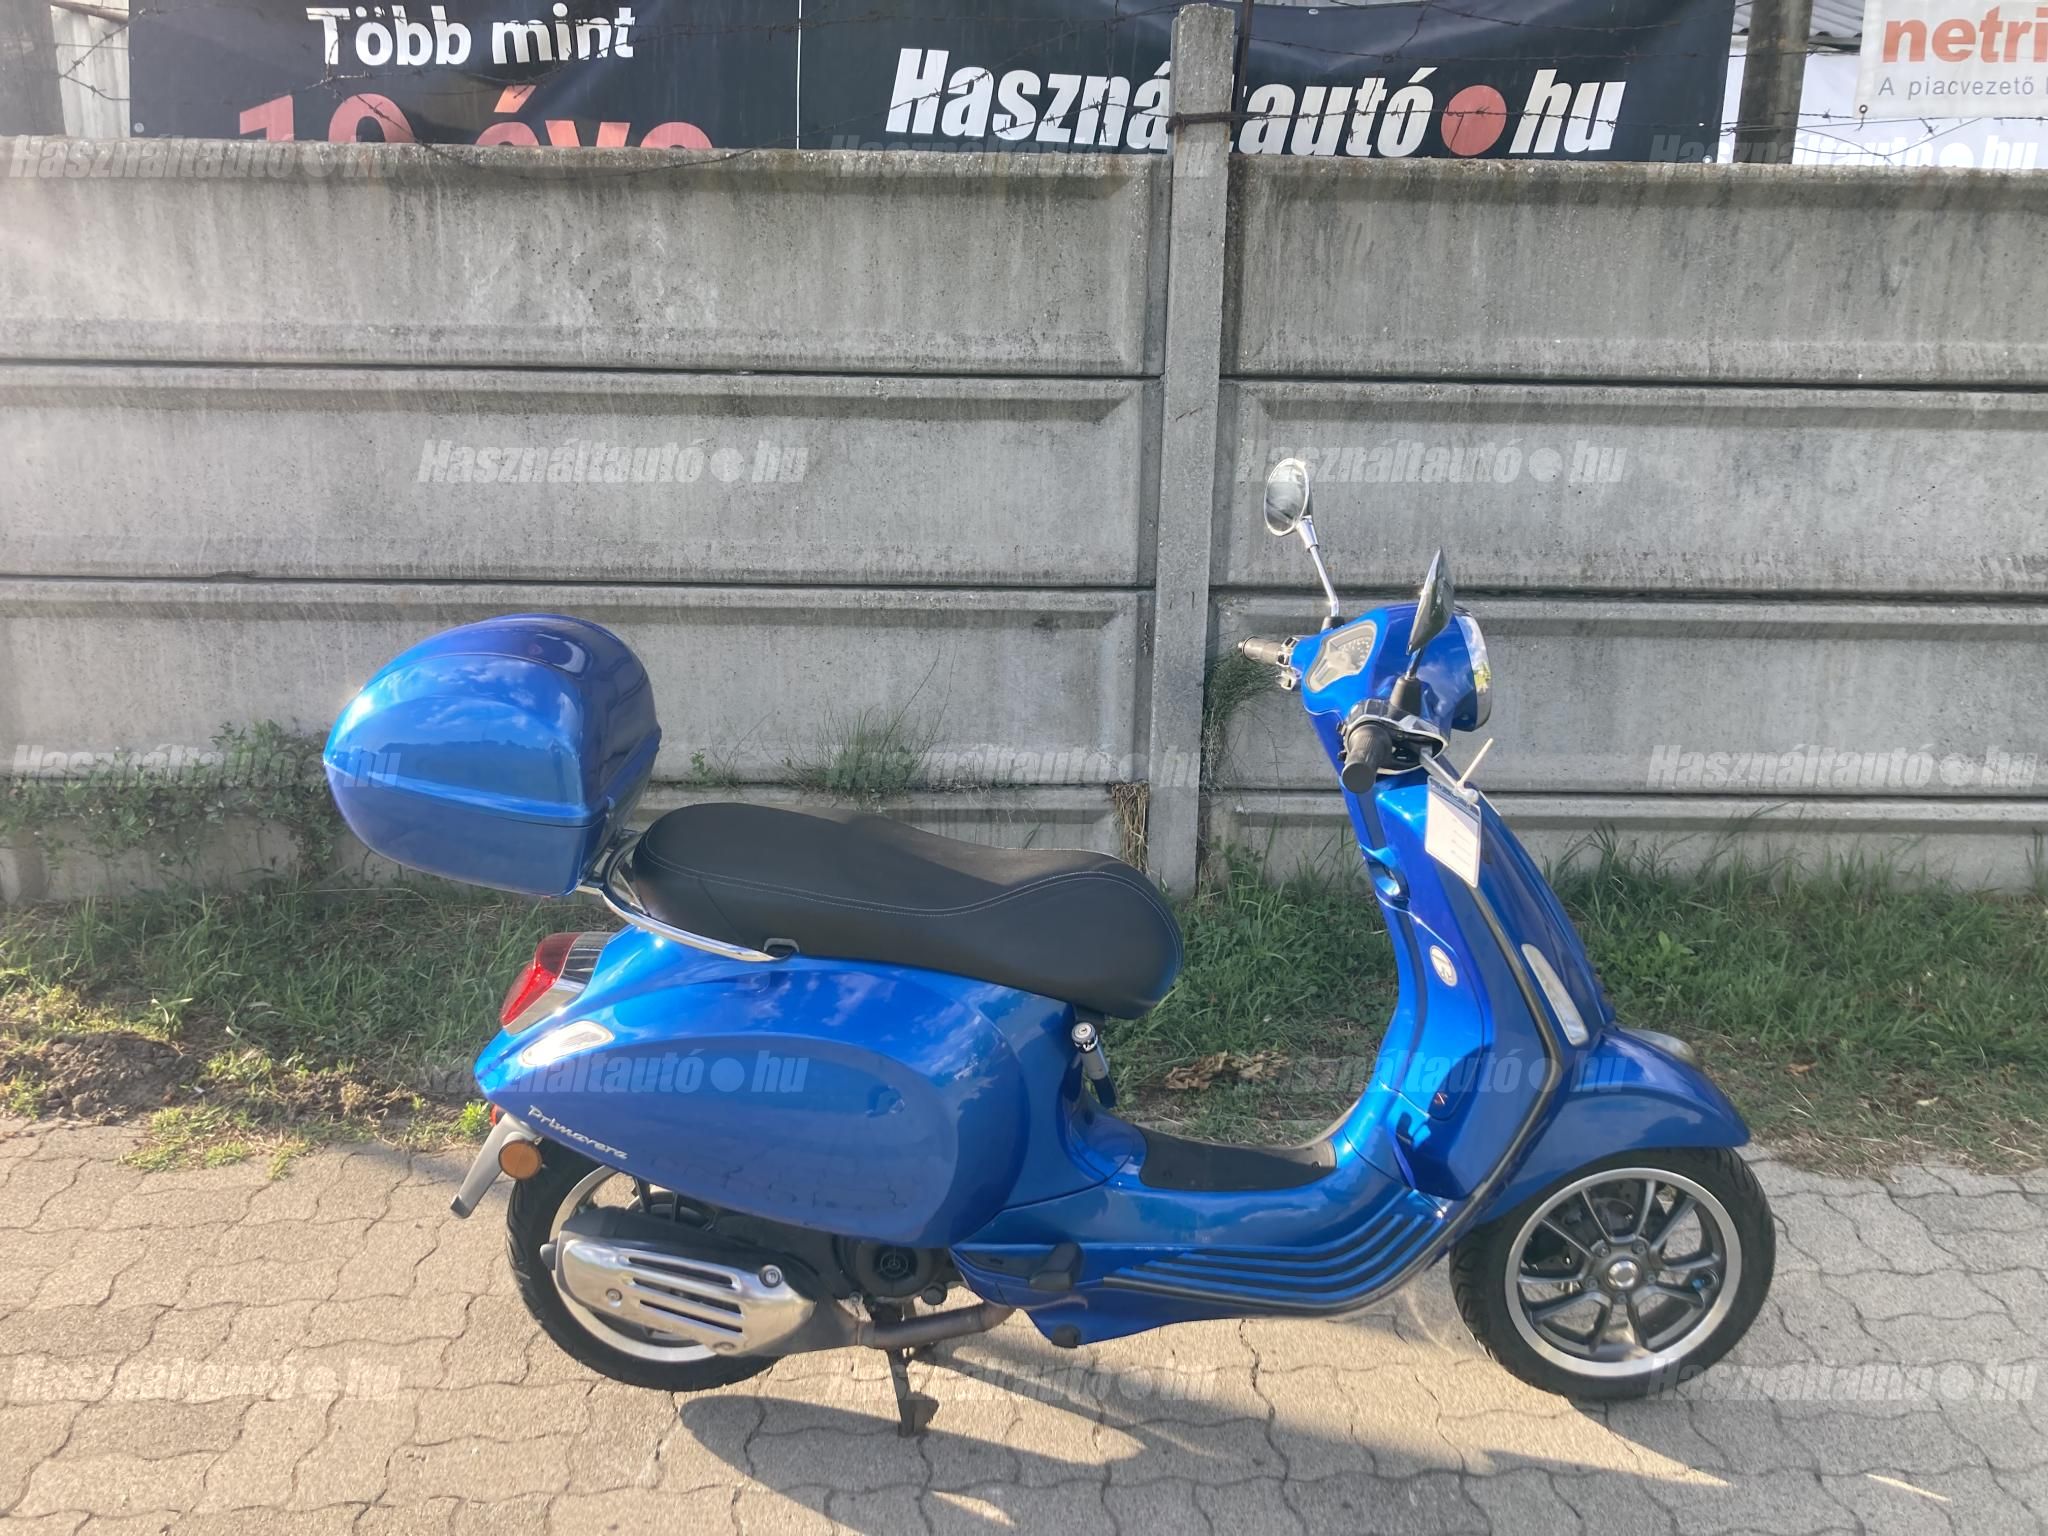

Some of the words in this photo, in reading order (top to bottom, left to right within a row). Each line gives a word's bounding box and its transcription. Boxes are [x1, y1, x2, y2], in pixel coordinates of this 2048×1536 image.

[307, 4, 471, 66] Több
[492, 2, 636, 63] mint
[1878, 77, 1895, 95] A
[1908, 76, 2034, 100] piacvezető
[528, 1104, 629, 1160] Primavera
